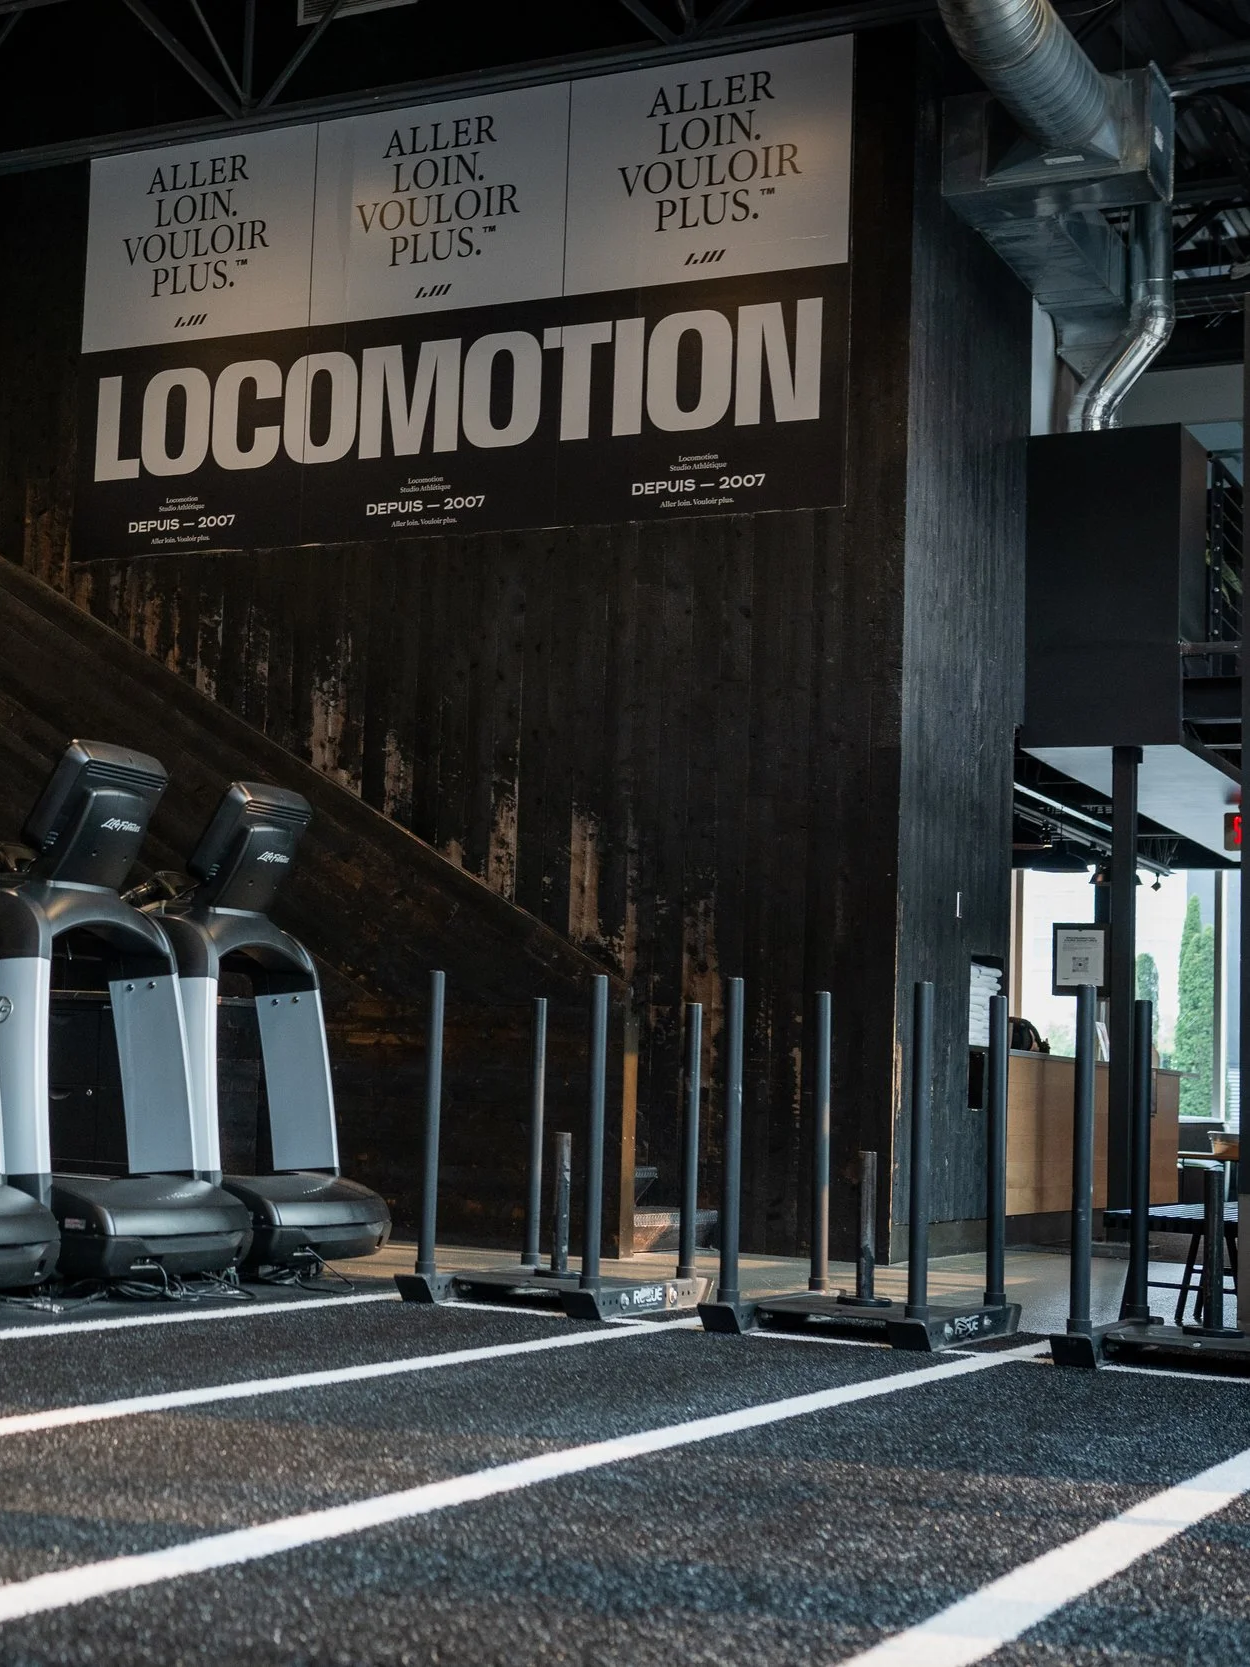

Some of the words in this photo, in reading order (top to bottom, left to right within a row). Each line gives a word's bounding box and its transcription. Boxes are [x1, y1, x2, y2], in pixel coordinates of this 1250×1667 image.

[646, 70, 775, 119] ALLER
[382, 115, 497, 159] ALLER
[657, 109, 761, 155] LOIN.
[146, 154, 249, 195] ALLER
[392, 151, 484, 194] LOIN.
[618, 143, 802, 198] VOULOIR
[155, 188, 237, 228] LOIN.
[356, 184, 520, 234] VOULOIR
[123, 220, 269, 266] VOULOIR
[93, 297, 824, 482] LOCOMOTION
[669, 464, 692, 472] Studio
[678, 453, 719, 463] Locomotion
[400, 485, 420, 493] Studio
[408, 476, 444, 485] Locomotion
[631, 478, 696, 496] DEPUIS
[718, 473, 766, 490] 2007
[165, 495, 199, 504] Locomotion
[366, 500, 423, 516] DEPUIS
[443, 495, 486, 510] 2007
[659, 500, 678, 509] Aller
[693, 497, 718, 506] Vouloir
[128, 519, 180, 534] DEPUIS
[198, 514, 236, 529] 2007
[391, 520, 407, 528] Aller
[420, 517, 443, 526] Vouloir
[100, 817, 121, 831] Life
[116, 820, 141, 833] Fitness
[633, 1286, 663, 1305] ROGUE
